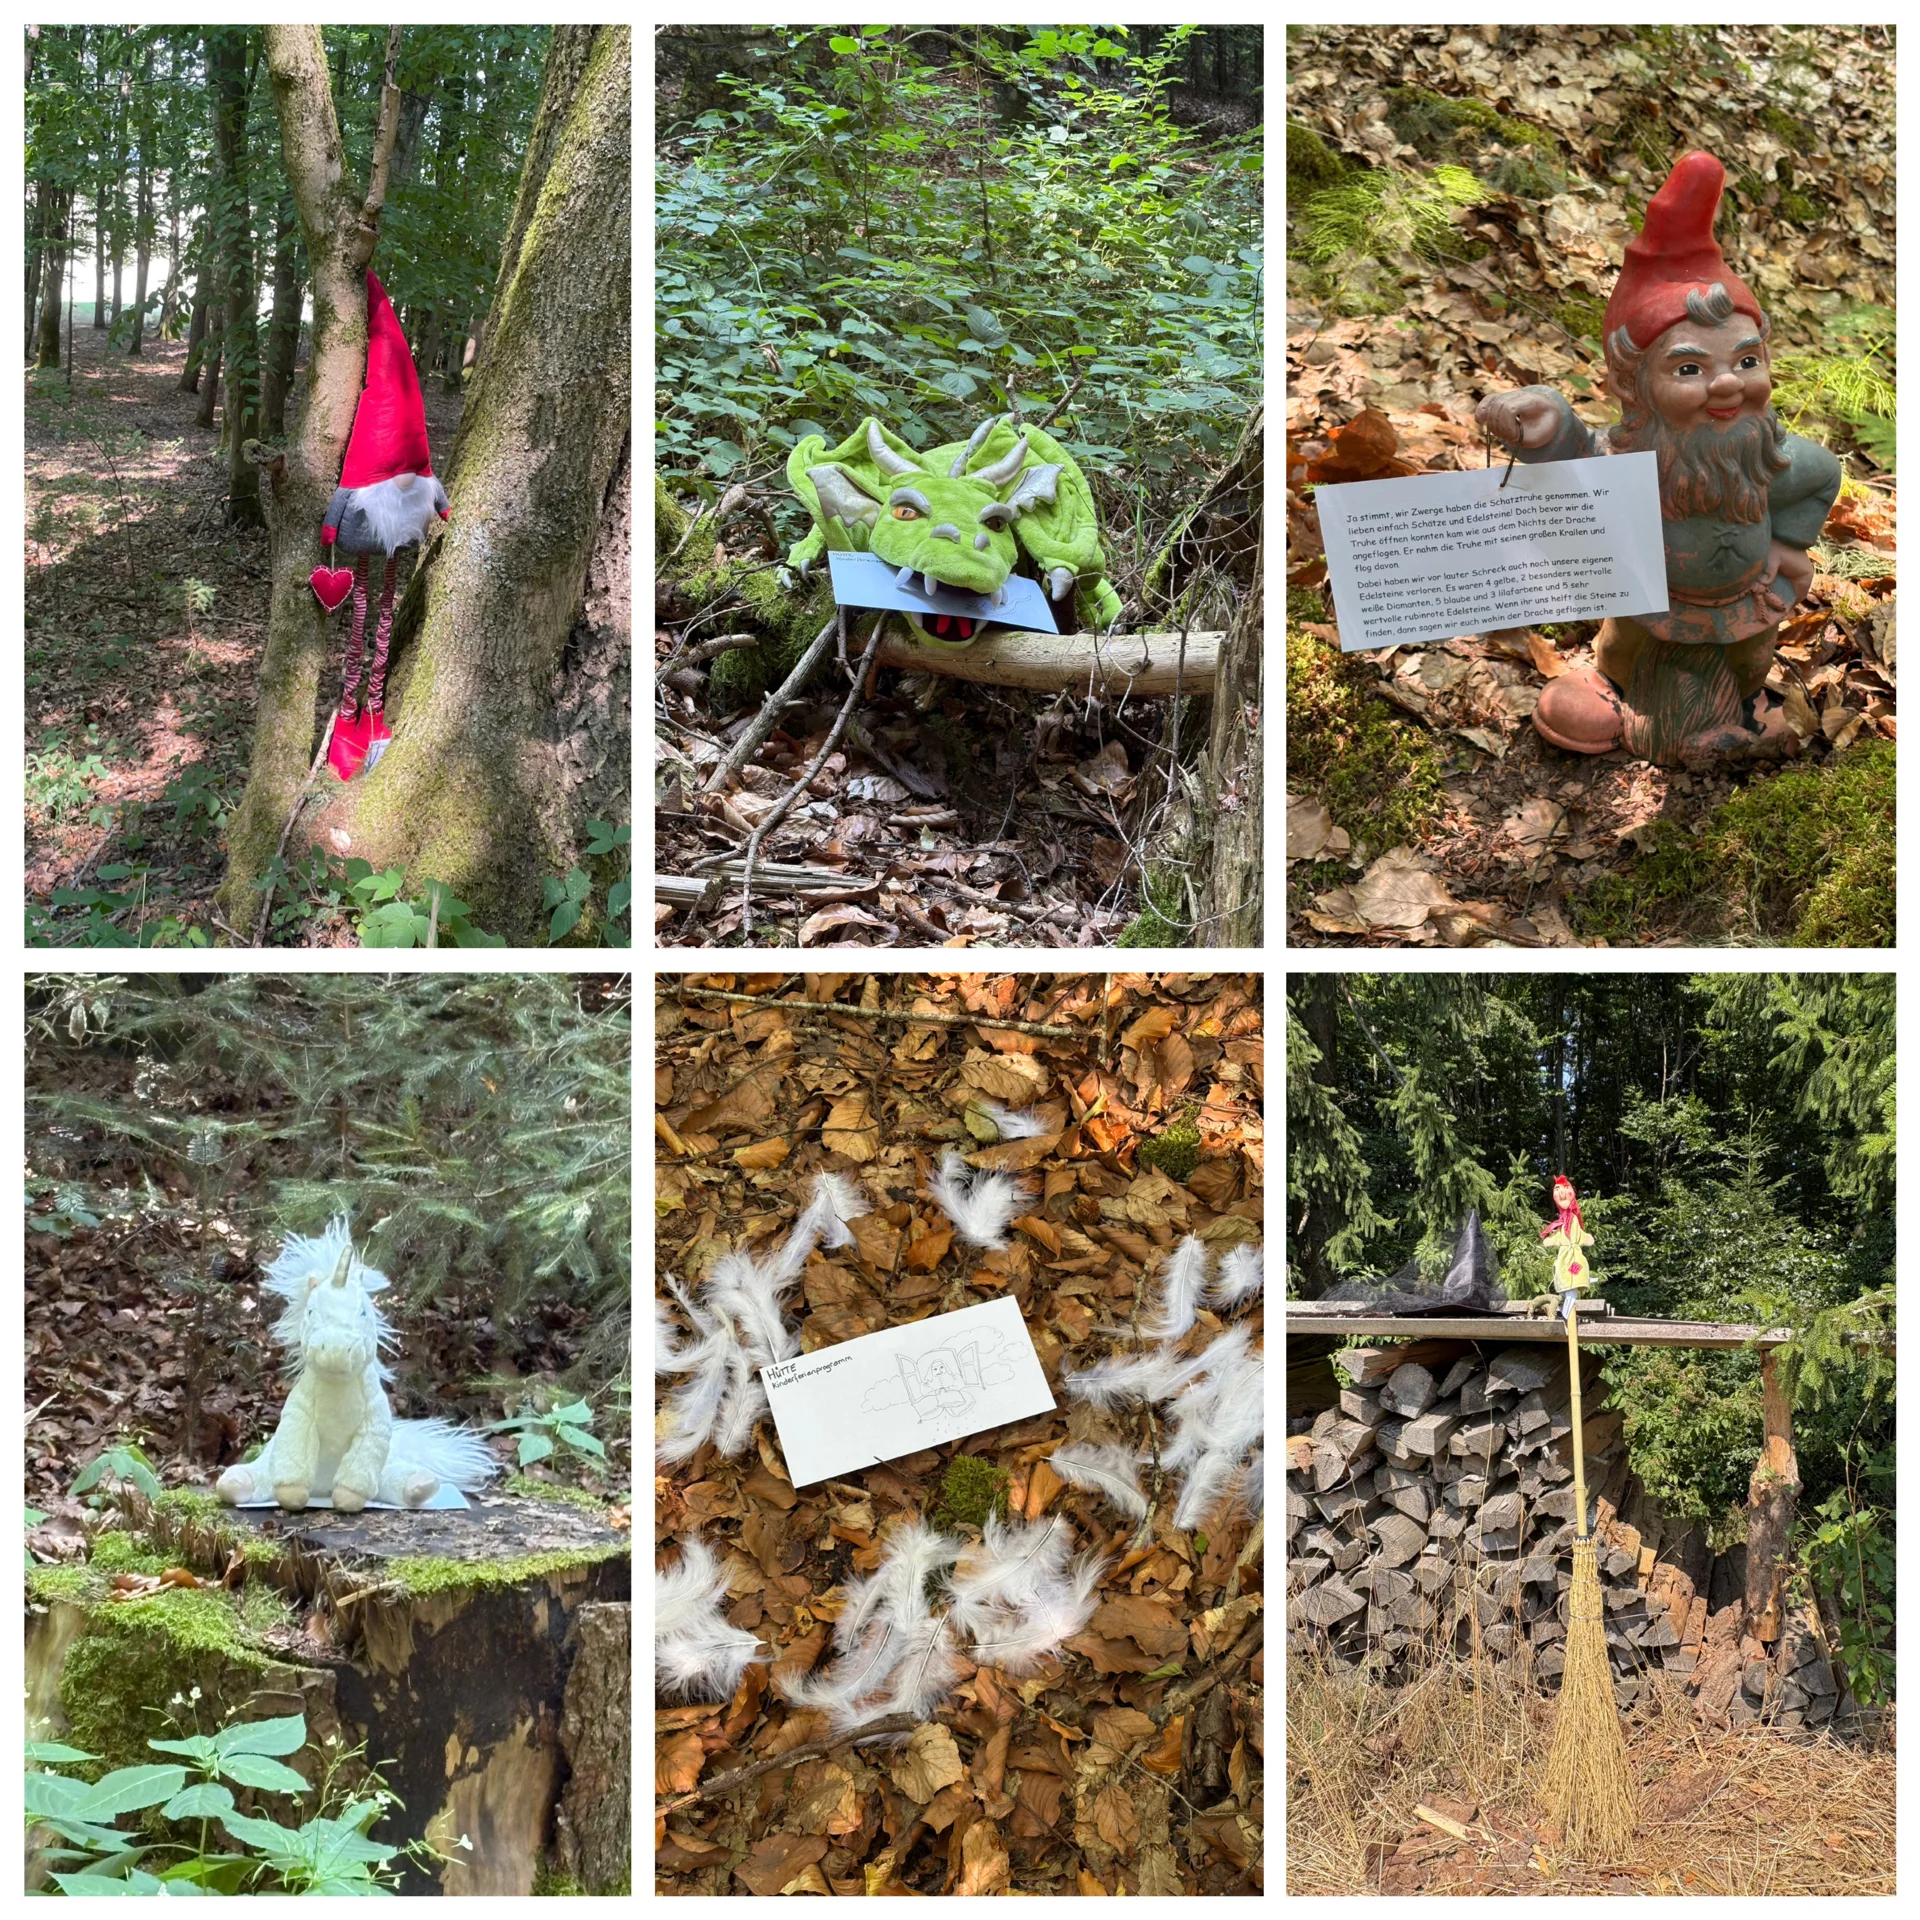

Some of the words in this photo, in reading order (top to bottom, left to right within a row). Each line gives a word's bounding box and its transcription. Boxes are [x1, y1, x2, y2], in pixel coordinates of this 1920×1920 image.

[1346, 514, 1358, 523] Ja
[1360, 511, 1393, 521] stimmt,
[1394, 509, 1409, 518] wir
[1411, 507, 1444, 516] Zwerge
[1445, 504, 1472, 513] haben
[1473, 500, 1487, 509] die
[1489, 493, 1543, 507] Schatztruhe
[1544, 492, 1591, 502] genommen.
[1592, 488, 1609, 497] Wir
[1348, 526, 1375, 535] lieben
[1376, 521, 1409, 532] einfach
[1411, 519, 1447, 529] Schätze
[1448, 516, 1465, 526] und
[1466, 508, 1513, 524] Edelsteine!
[1515, 505, 1537, 516] Doch
[1538, 505, 1563, 513] bevor
[1564, 503, 1579, 511] wir
[1580, 503, 1594, 511] die
[1350, 538, 1377, 547] Truhe
[1378, 535, 1409, 545] öffnen
[1410, 532, 1445, 541] konnten
[1446, 530, 1464, 538] kam
[1465, 527, 1480, 536] wie
[1481, 525, 1496, 534] aus
[1498, 522, 1516, 531] dem
[1517, 518, 1546, 528] Nichts
[1548, 517, 1563, 525] der
[1565, 515, 1596, 524] Drache
[1352, 549, 1402, 561] angeflogen.
[1403, 546, 1414, 555] Er
[1415, 545, 1439, 554] nahm
[1440, 543, 1454, 551] die
[1456, 540, 1482, 549] Truhe
[1483, 537, 1498, 546] mit
[1500, 533, 1527, 543] seinen
[1528, 529, 1557, 541] großen
[1558, 528, 1588, 536] Krallen
[1589, 526, 1605, 535] und
[1354, 564, 1372, 573] flog
[1373, 562, 1400, 570] davon.
[1357, 579, 1382, 589] Dabei
[1383, 577, 1410, 586] haben
[1411, 575, 1425, 583] wir
[1443, 571, 1469, 580] lauter
[1471, 564, 1507, 577] Schreck
[1507, 561, 1528, 571] auch
[1529, 558, 1550, 568] noch
[1551, 558, 1579, 566] unsere
[1581, 556, 1614, 566] eigenen
[1359, 590, 1404, 601] Edelsteine
[1405, 586, 1443, 596] verloren.
[1445, 583, 1456, 592] Es
[1457, 582, 1484, 591] waren
[1485, 579, 1491, 587] 4
[1493, 576, 1519, 588] gelbe,
[1520, 573, 1526, 581] 2
[1528, 570, 1571, 580] besonders
[1573, 567, 1612, 576] wertvolle
[1361, 603, 1385, 613] weiße
[1386, 600, 1433, 610] Diamanten,
[1435, 597, 1442, 605] 5
[1443, 595, 1471, 604] blaube
[1473, 592, 1488, 601] und
[1490, 590, 1496, 599] 3
[1498, 585, 1543, 597] lilafarbene
[1545, 582, 1560, 591] und
[1562, 581, 1568, 589] 5
[1570, 580, 1589, 589] sehr
[1362, 614, 1402, 625] wertvolle
[1404, 610, 1445, 621] rubinrote
[1446, 605, 1492, 616] Edelsteine.
[1494, 601, 1519, 610] Wenn
[1550, 593, 1572, 602] helft
[1574, 593, 1587, 601] die
[1589, 592, 1617, 600] Steine
[1365, 628, 1395, 638] finden,
[1396, 626, 1417, 634] dann
[1418, 623, 1443, 633] sagen
[1459, 617, 1479, 627] euch
[1481, 615, 1505, 624] wohin
[1506, 612, 1522, 620] der
[1523, 607, 1554, 618] Drache
[1555, 605, 1592, 616] geflogen
